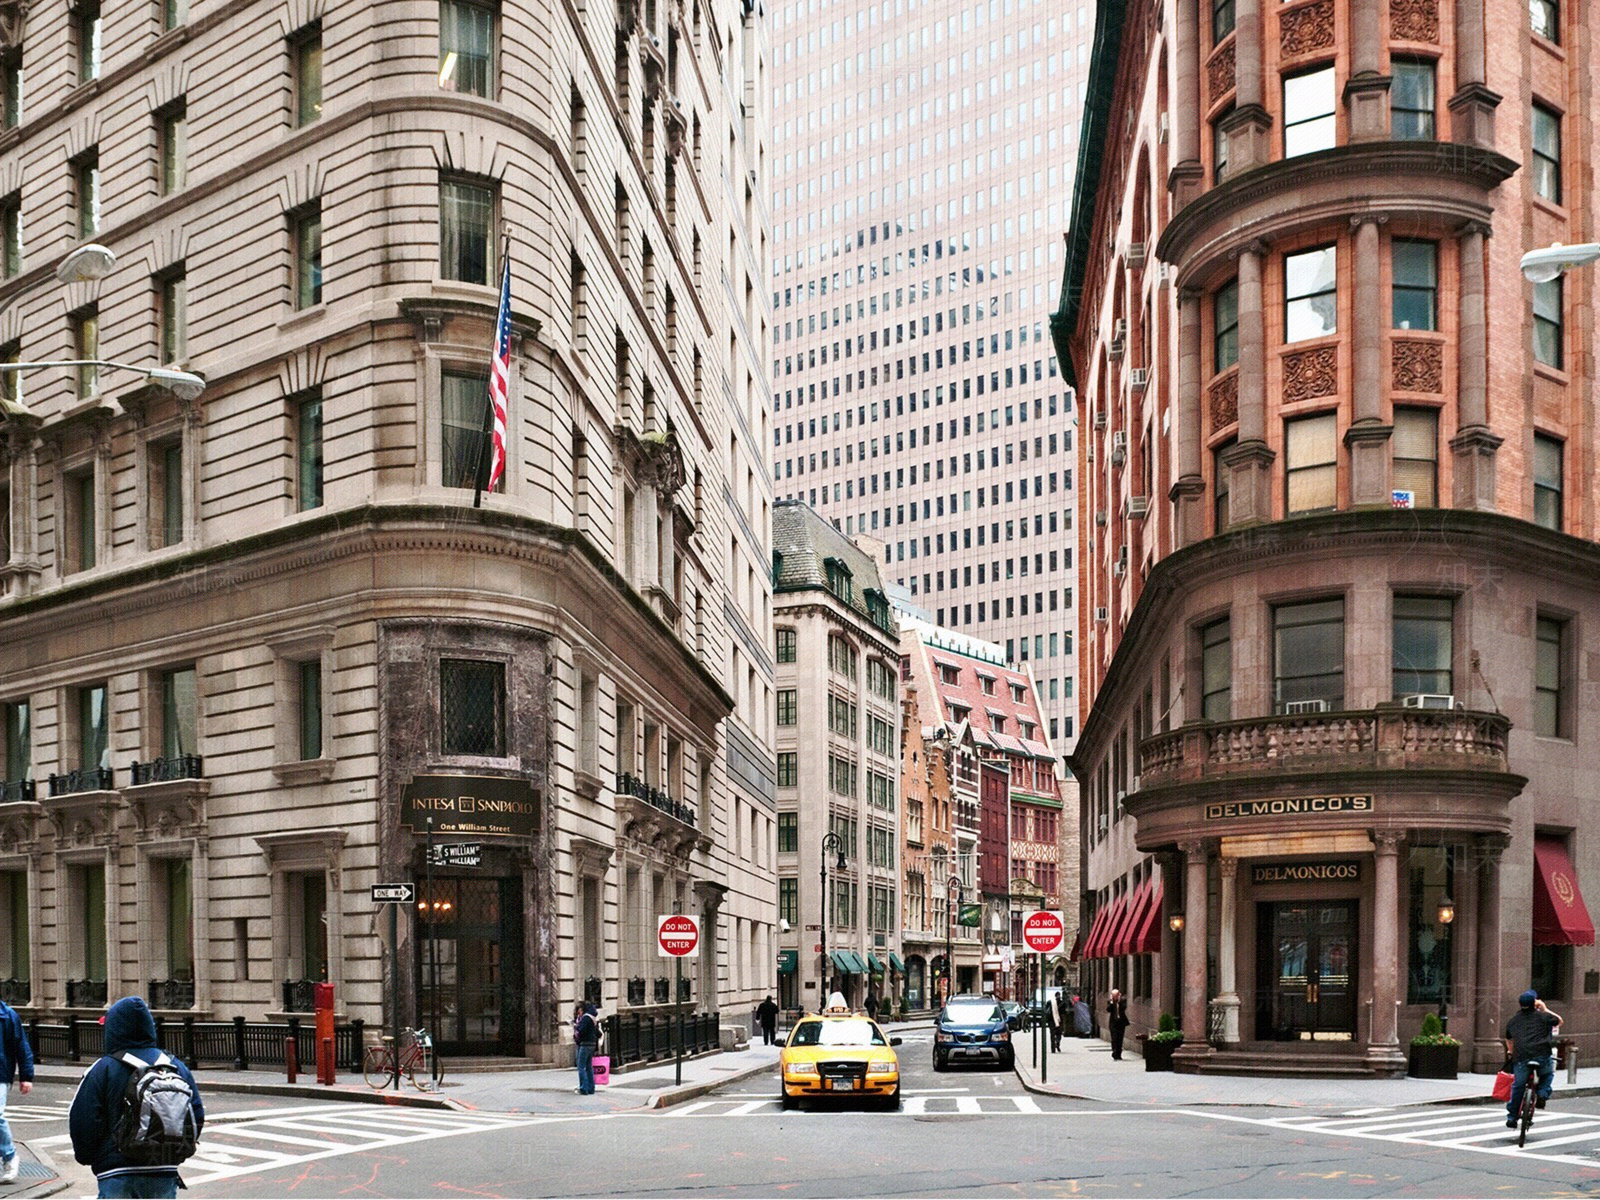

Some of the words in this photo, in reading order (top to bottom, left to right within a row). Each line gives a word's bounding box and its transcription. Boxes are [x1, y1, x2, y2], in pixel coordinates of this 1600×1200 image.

[1392, 500, 1410, 508] NYC
[412, 798, 455, 810] INTESA
[477, 799, 533, 814] SANPAOLO
[1209, 796, 1368, 819] DELMONICO'S
[440, 823, 456, 831] One
[458, 823, 487, 831] William
[444, 848, 449, 857] S
[450, 846, 476, 856] WILLIAM
[1255, 865, 1358, 881] DELMONICOS
[376, 889, 390, 897] ONE
[393, 889, 408, 897] WAY
[665, 923, 676, 931] DO
[677, 923, 692, 931] NOT
[1030, 919, 1041, 927] DO
[1042, 919, 1056, 927] NOT
[667, 941, 690, 949] ENTER
[1032, 937, 1055, 945] ENTER
